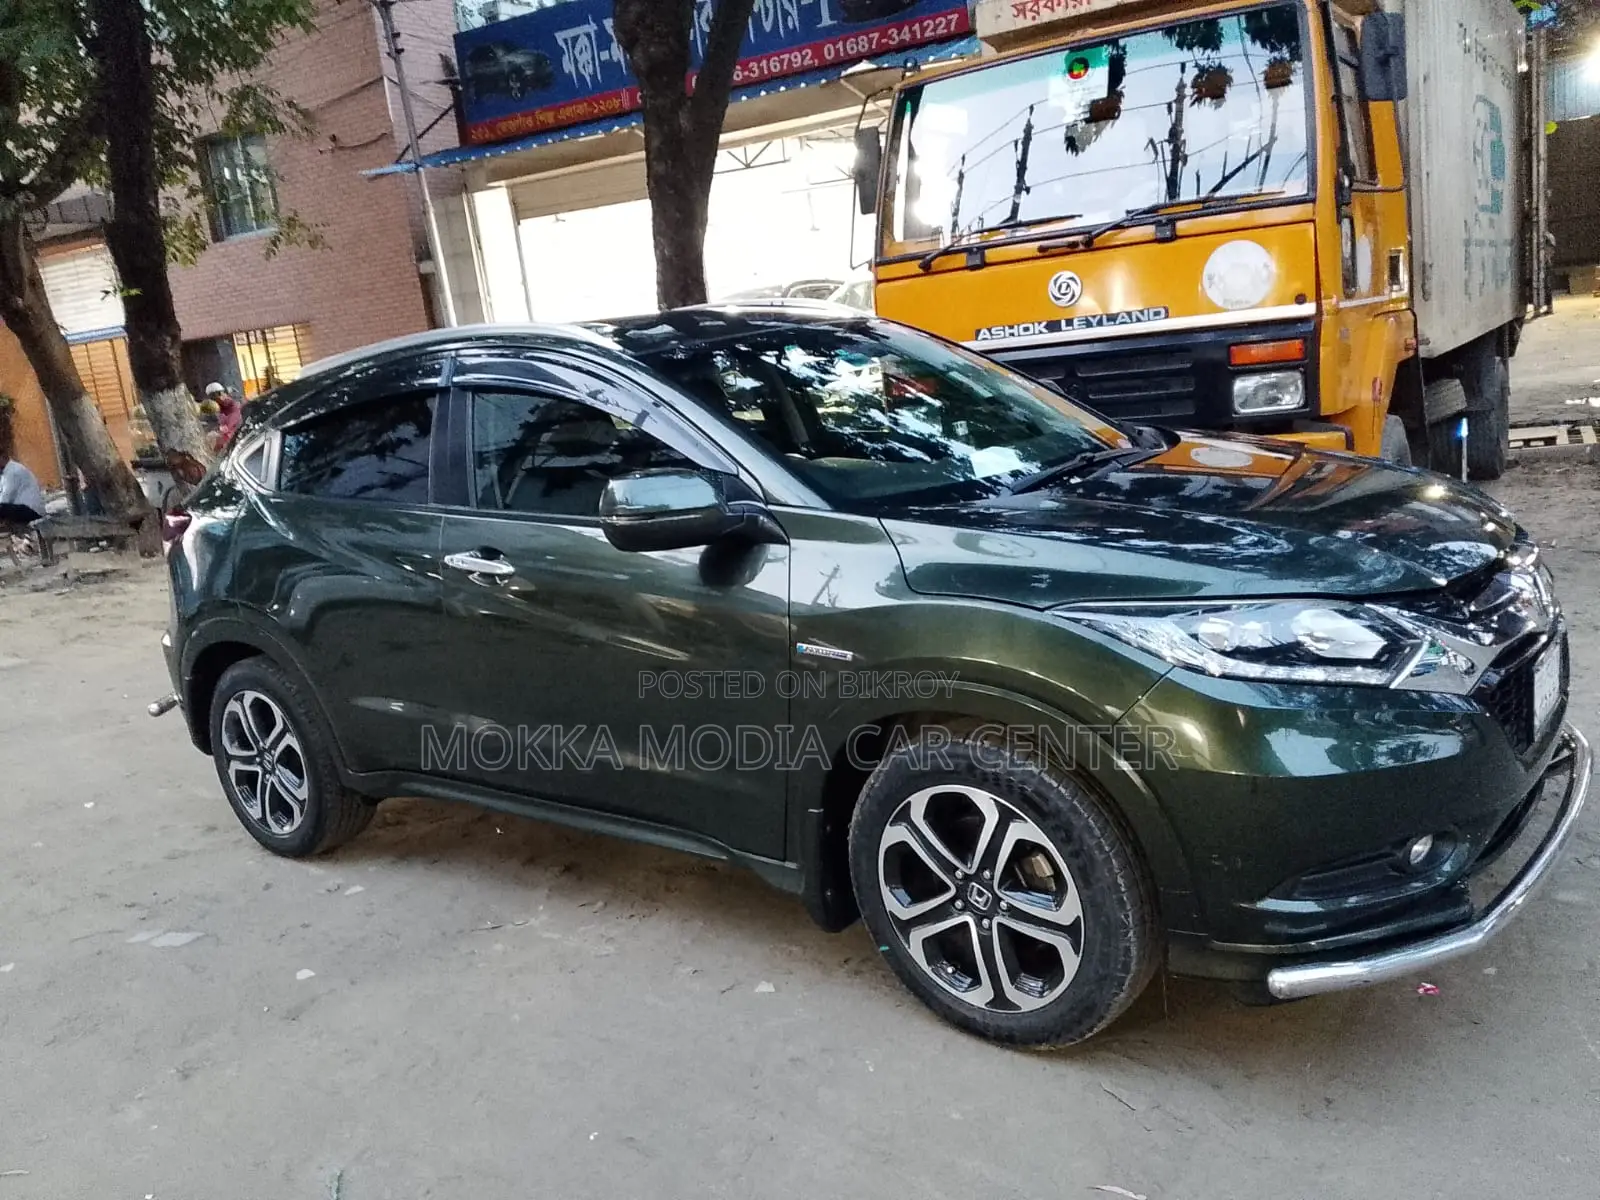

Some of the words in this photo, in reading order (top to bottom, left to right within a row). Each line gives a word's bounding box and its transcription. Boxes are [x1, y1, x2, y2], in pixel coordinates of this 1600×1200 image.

[823, 13, 960, 61] 01687-341227
[977, 321, 1049, 341] ASHOK
[1060, 306, 1167, 331] LEYLAND
